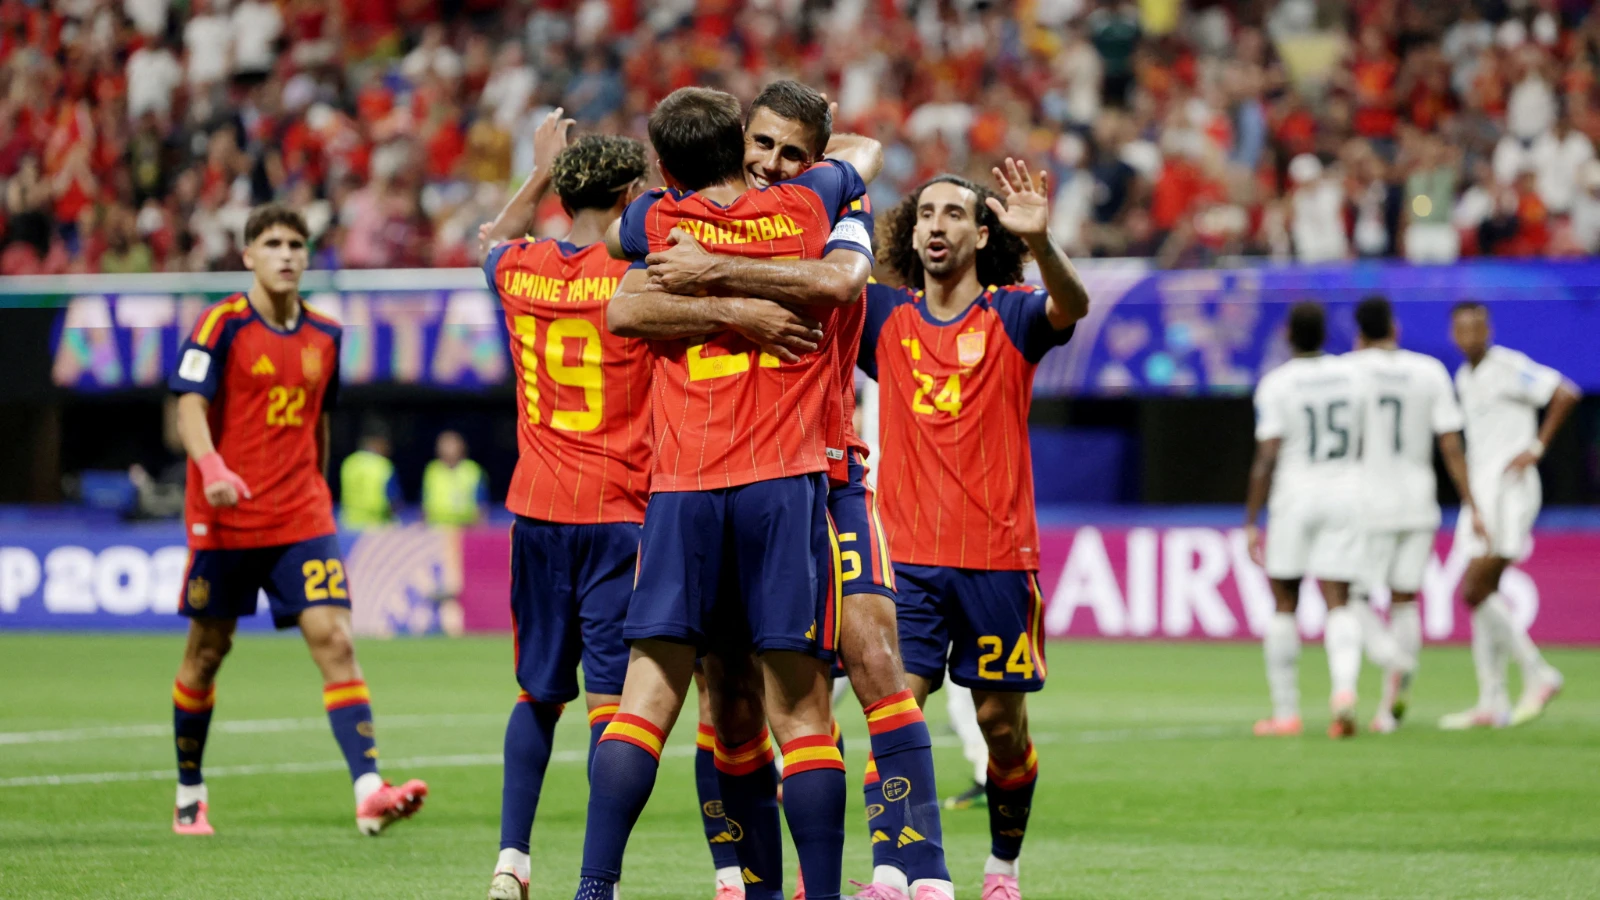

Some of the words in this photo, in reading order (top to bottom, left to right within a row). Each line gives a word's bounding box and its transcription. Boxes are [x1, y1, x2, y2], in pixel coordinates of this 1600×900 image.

[504, 271, 565, 302] LAMINE
[51, 290, 508, 387] ATNTA
[514, 315, 604, 432] 19
[912, 369, 962, 416] 24
[266, 385, 306, 426] 22
[1305, 400, 1349, 462] 15
[44, 545, 272, 614] 202
[302, 558, 348, 601] 22
[1045, 525, 1539, 639] AIRYS
[977, 632, 1035, 680] 24
[886, 781, 902, 790] RF
[887, 788, 903, 798] EF
